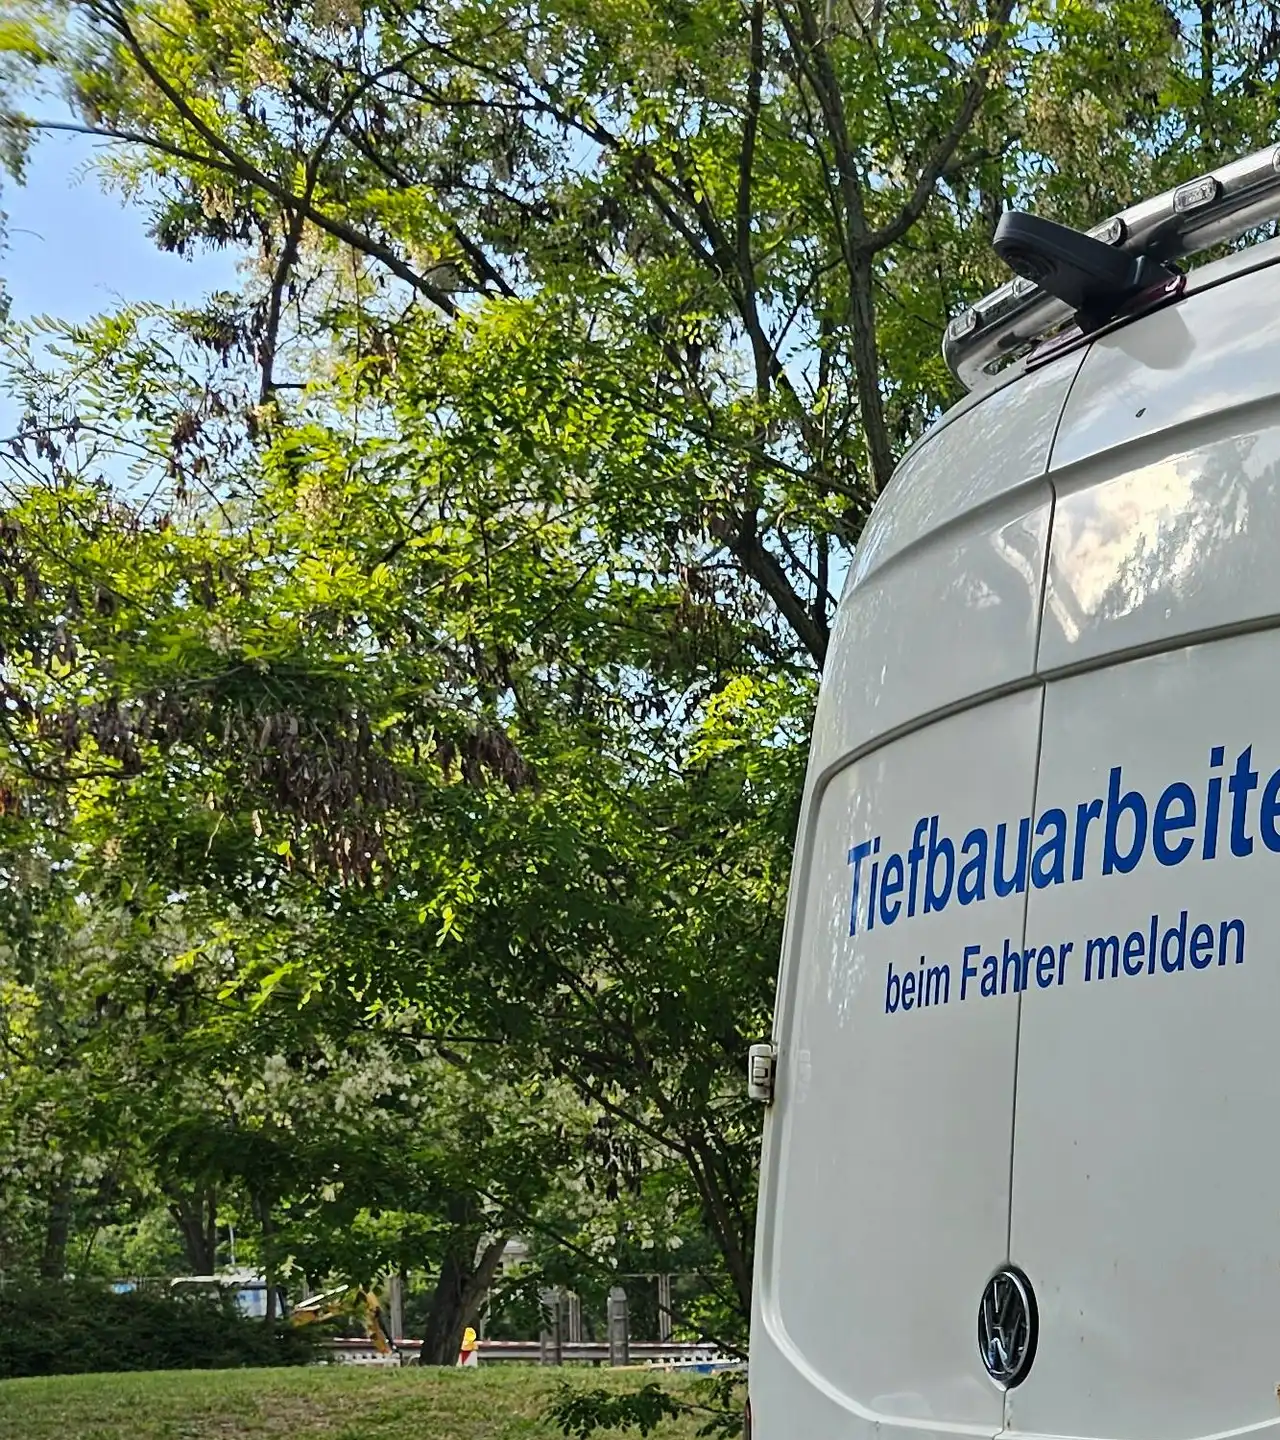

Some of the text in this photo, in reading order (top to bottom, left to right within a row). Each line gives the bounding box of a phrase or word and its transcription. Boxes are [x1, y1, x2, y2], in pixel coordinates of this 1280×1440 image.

[885, 910, 1245, 1014] beim Fahrer melden
